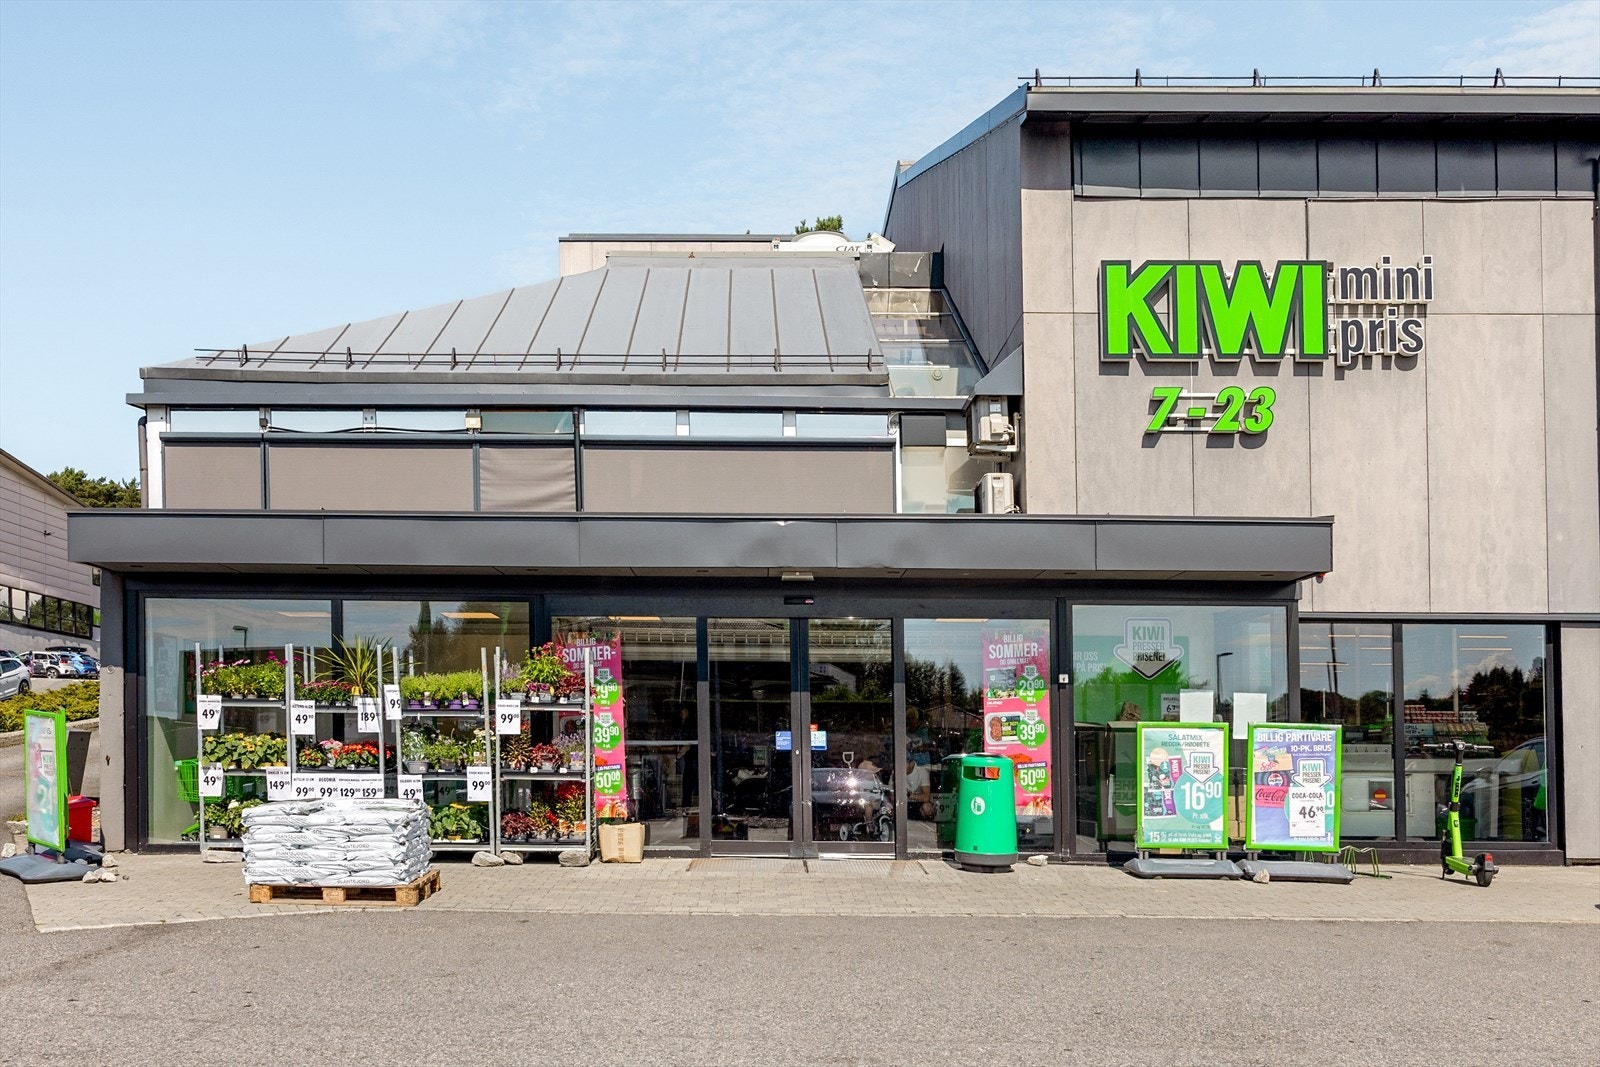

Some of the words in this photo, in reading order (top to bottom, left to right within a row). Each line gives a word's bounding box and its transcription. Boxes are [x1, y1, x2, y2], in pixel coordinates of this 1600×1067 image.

[1338, 255, 1433, 302] mini
[1099, 260, 1327, 361] KIWI
[1338, 307, 1425, 366] pris
[1145, 387, 1182, 432] 7
[1210, 386, 1276, 433] 23
[1003, 634, 1024, 643] BILLIG
[1132, 626, 1165, 641] KIWI
[576, 637, 596, 646] BILLIG
[1132, 642, 1165, 651] PRESSER
[988, 642, 1043, 659] SOMMER-
[1132, 651, 1166, 661] PRISENE!
[1076, 660, 1087, 673] PÅ
[1257, 733, 1283, 743] BILLIG
[1285, 732, 1332, 743] PARTIVARE
[1302, 764, 1321, 772] KIWI
